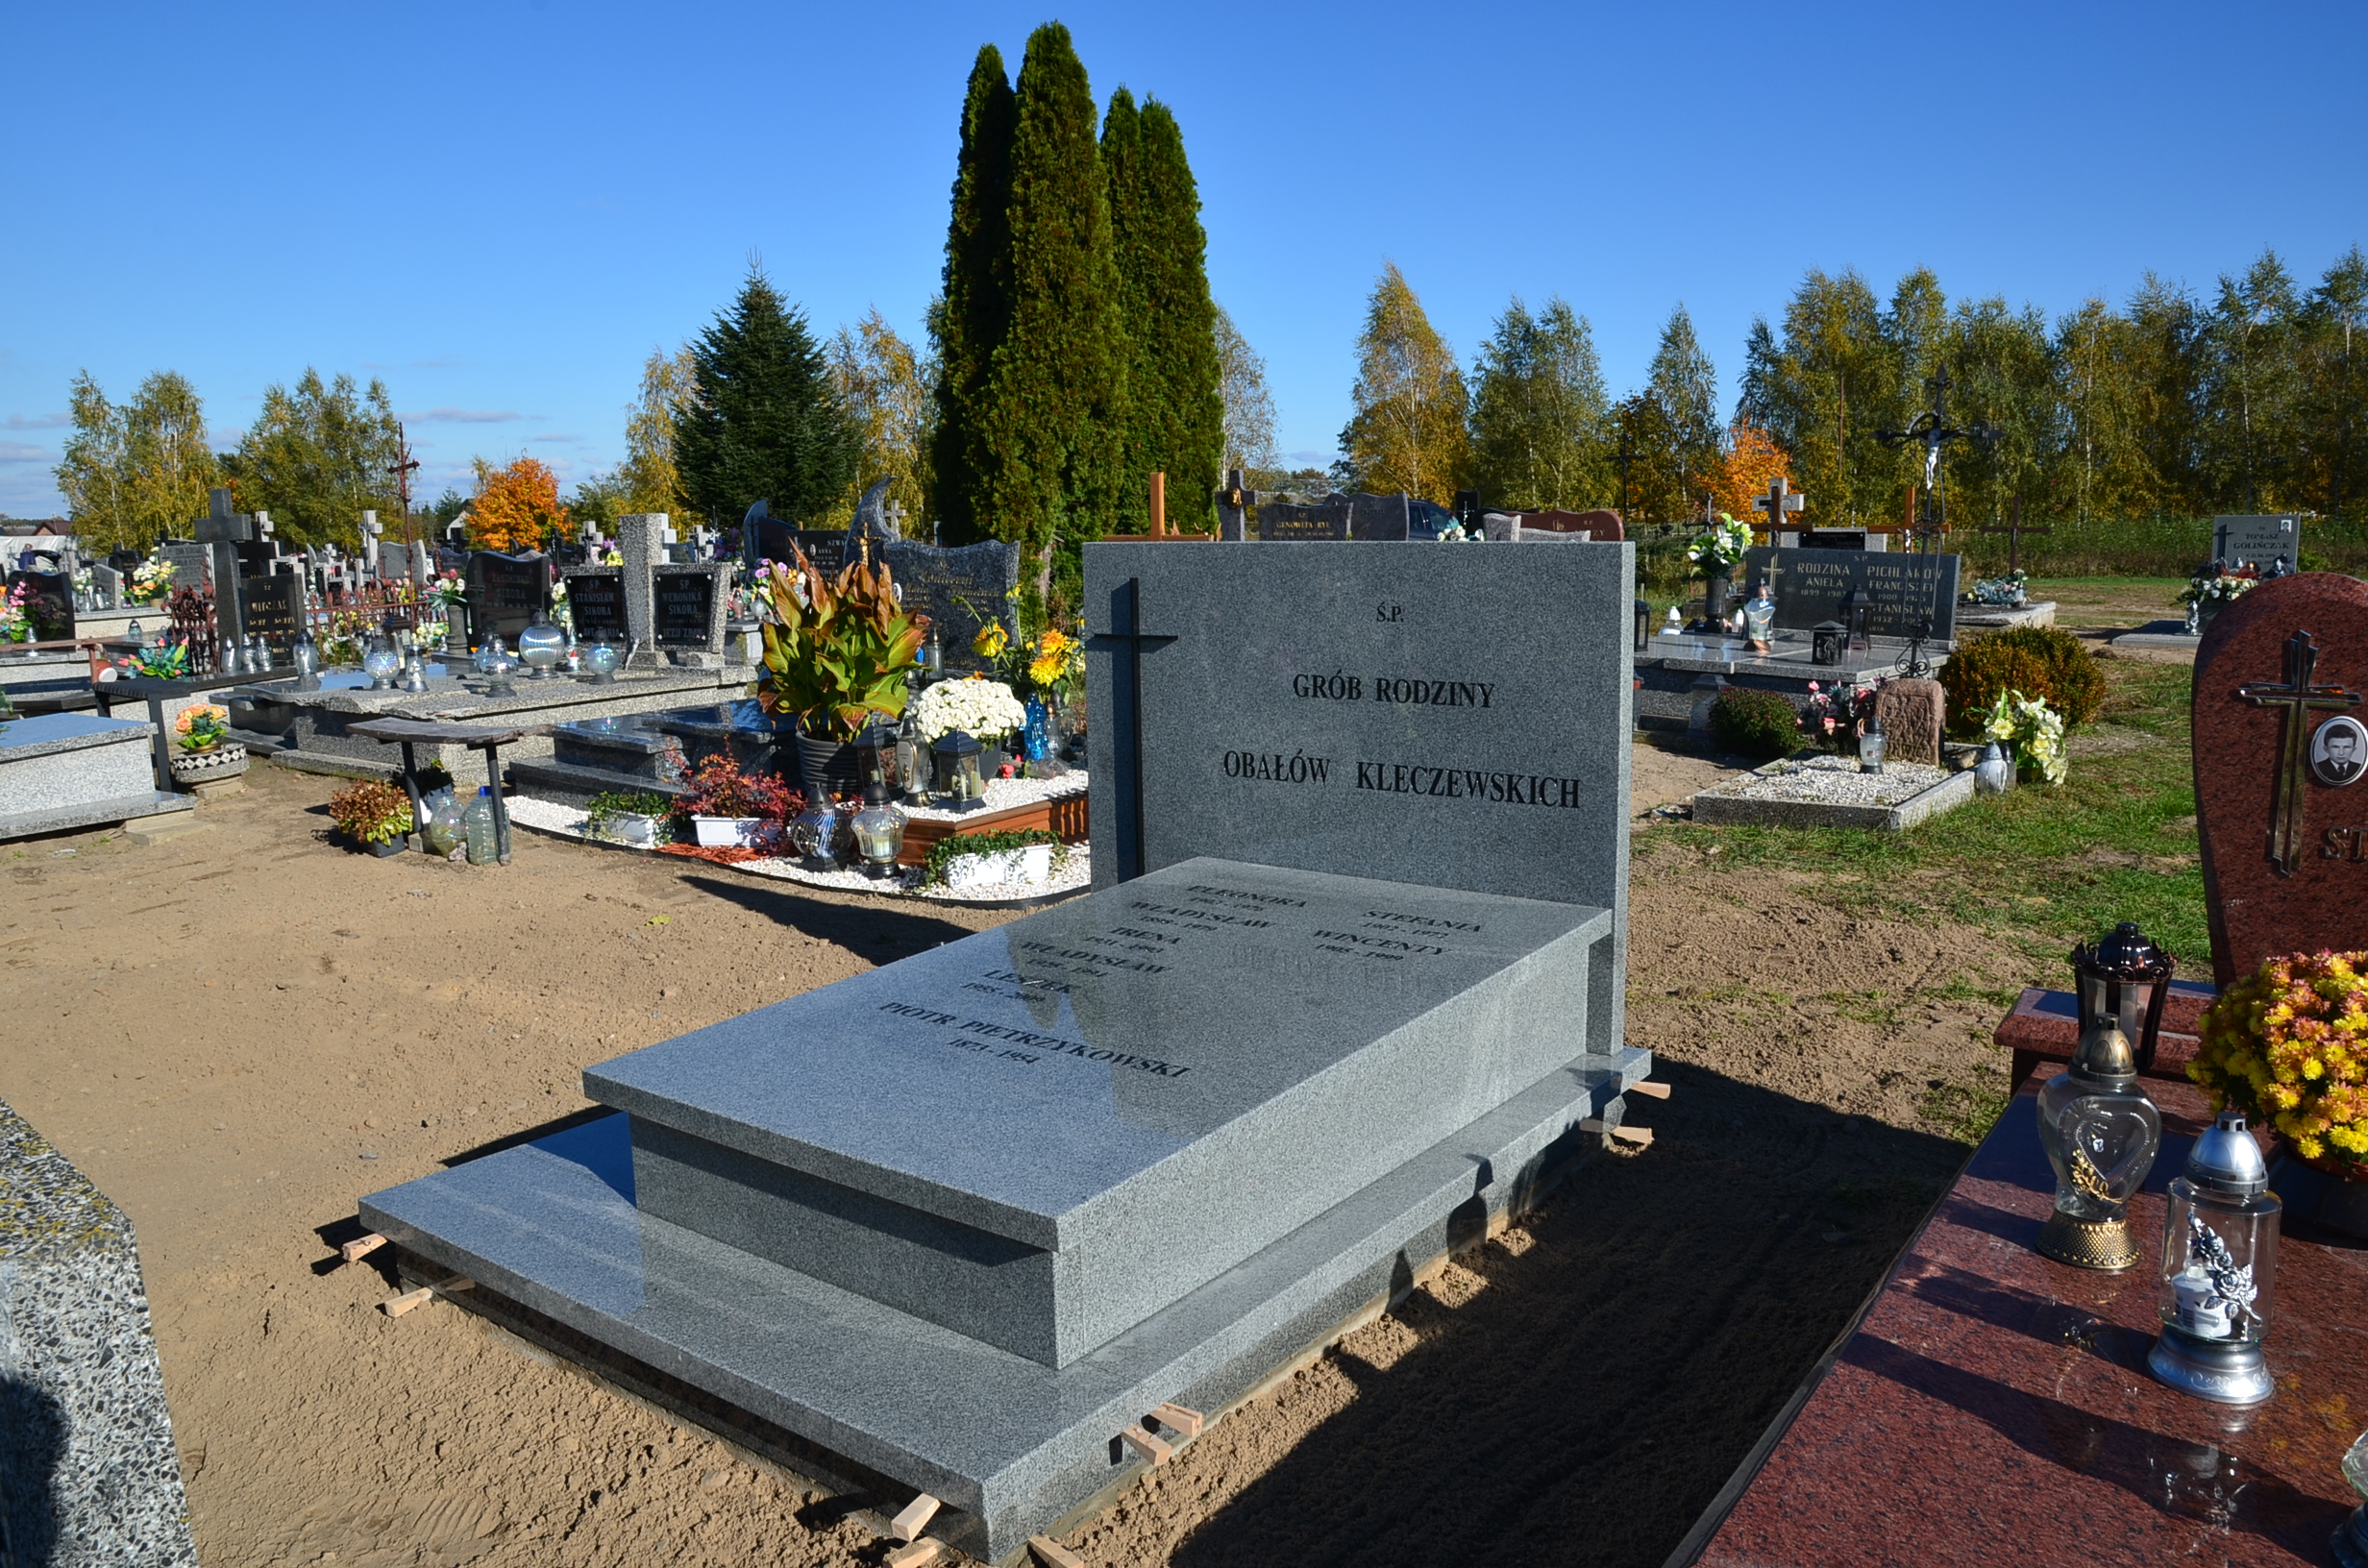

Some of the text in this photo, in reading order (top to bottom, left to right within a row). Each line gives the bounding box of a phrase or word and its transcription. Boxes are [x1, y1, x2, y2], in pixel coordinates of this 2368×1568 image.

[1797, 562, 1850, 576] RODZINA
[1806, 576, 1844, 588] ANIELA
[661, 592, 703, 602] WERONIKA
[583, 606, 612, 616] SIKORA
[668, 604, 699, 615] SIKORA
[1376, 601, 1404, 624] Ś.P.
[1293, 669, 1495, 709] GRÓB RODZINY
[1223, 748, 1581, 809] OBAŁÓW KLECZEWSKICH
[1187, 885, 1308, 908] ELEONORA
[1130, 901, 1277, 929] WŁADYSŁAW
[1361, 910, 1481, 933] STEFANIA
[1109, 926, 1181, 944] IRENA
[1313, 929, 1452, 956] WINCENTY
[1021, 941, 1174, 974] WŁADYSŁAW
[981, 969, 1082, 994] LESZEK
[878, 1001, 1192, 1078] PIOTR PIETRZYKOWSKI
[947, 1038, 990, 1053] 1873
[998, 1049, 1042, 1065] 1954
